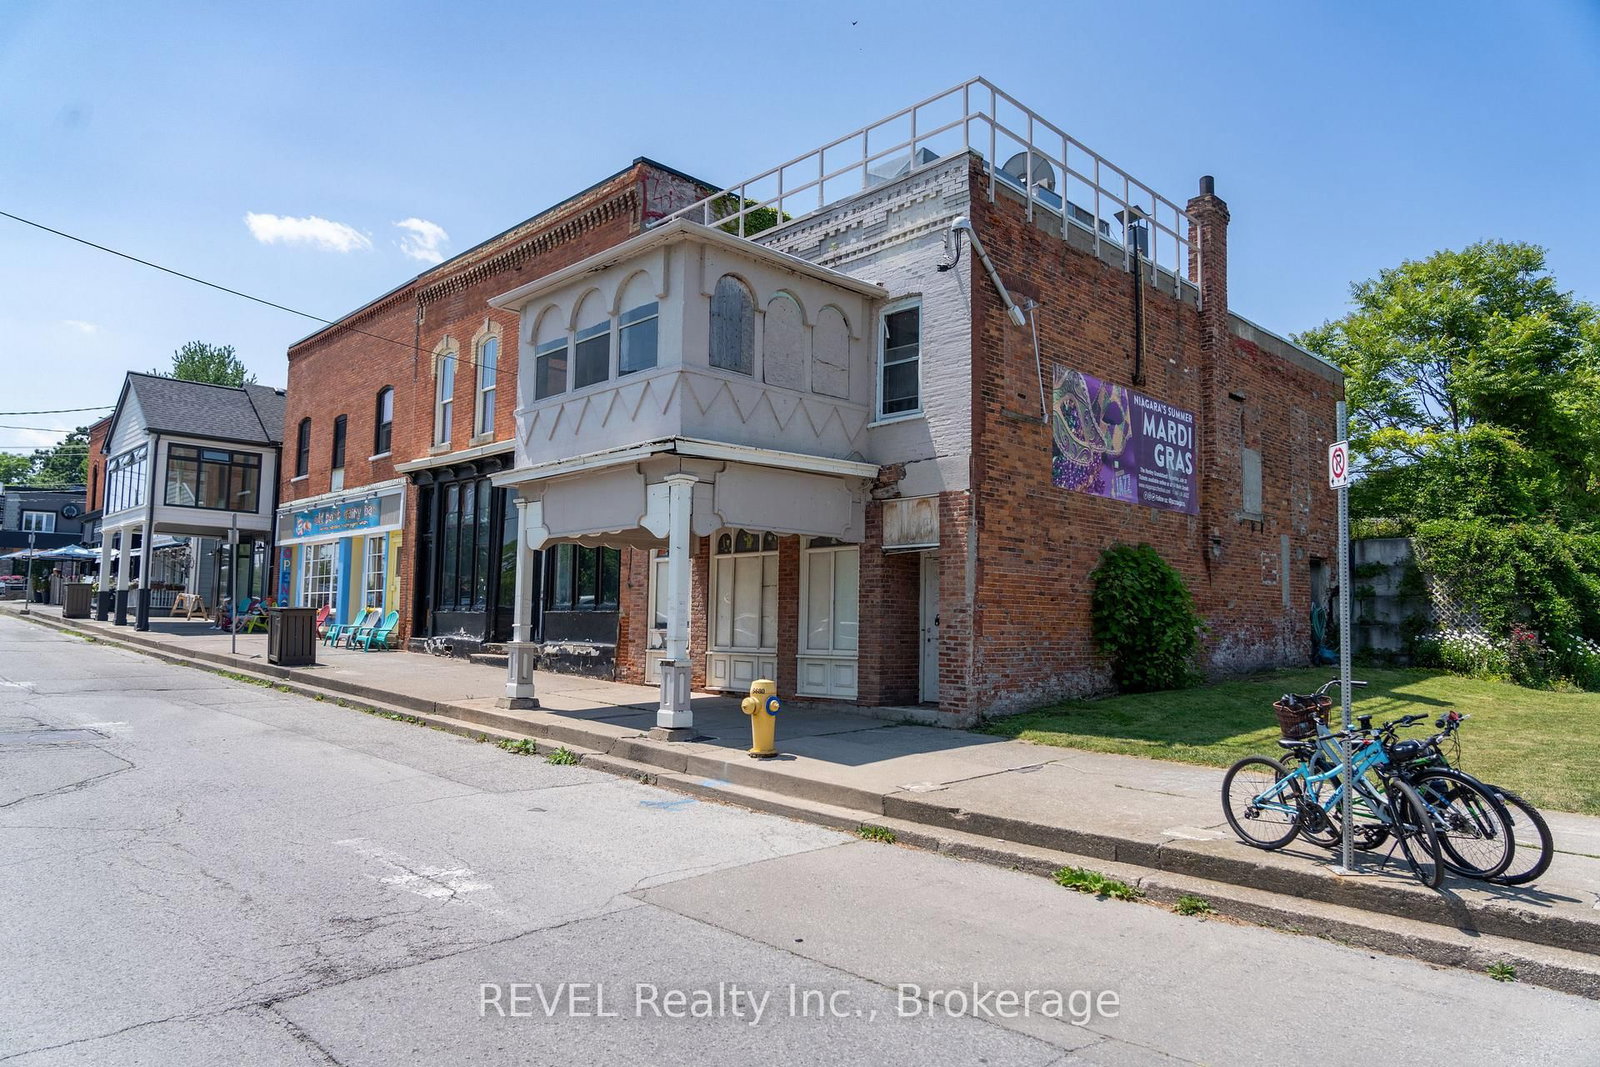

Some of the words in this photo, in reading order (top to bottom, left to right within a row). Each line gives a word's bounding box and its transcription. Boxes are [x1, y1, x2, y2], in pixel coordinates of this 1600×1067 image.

[1134, 395, 1167, 415] NIAGARA'S
[1167, 407, 1193, 424] SUMMER
[1143, 412, 1192, 449] MARDI
[1154, 443, 1193, 475] GRAS
[282, 548, 292, 594] OPEN
